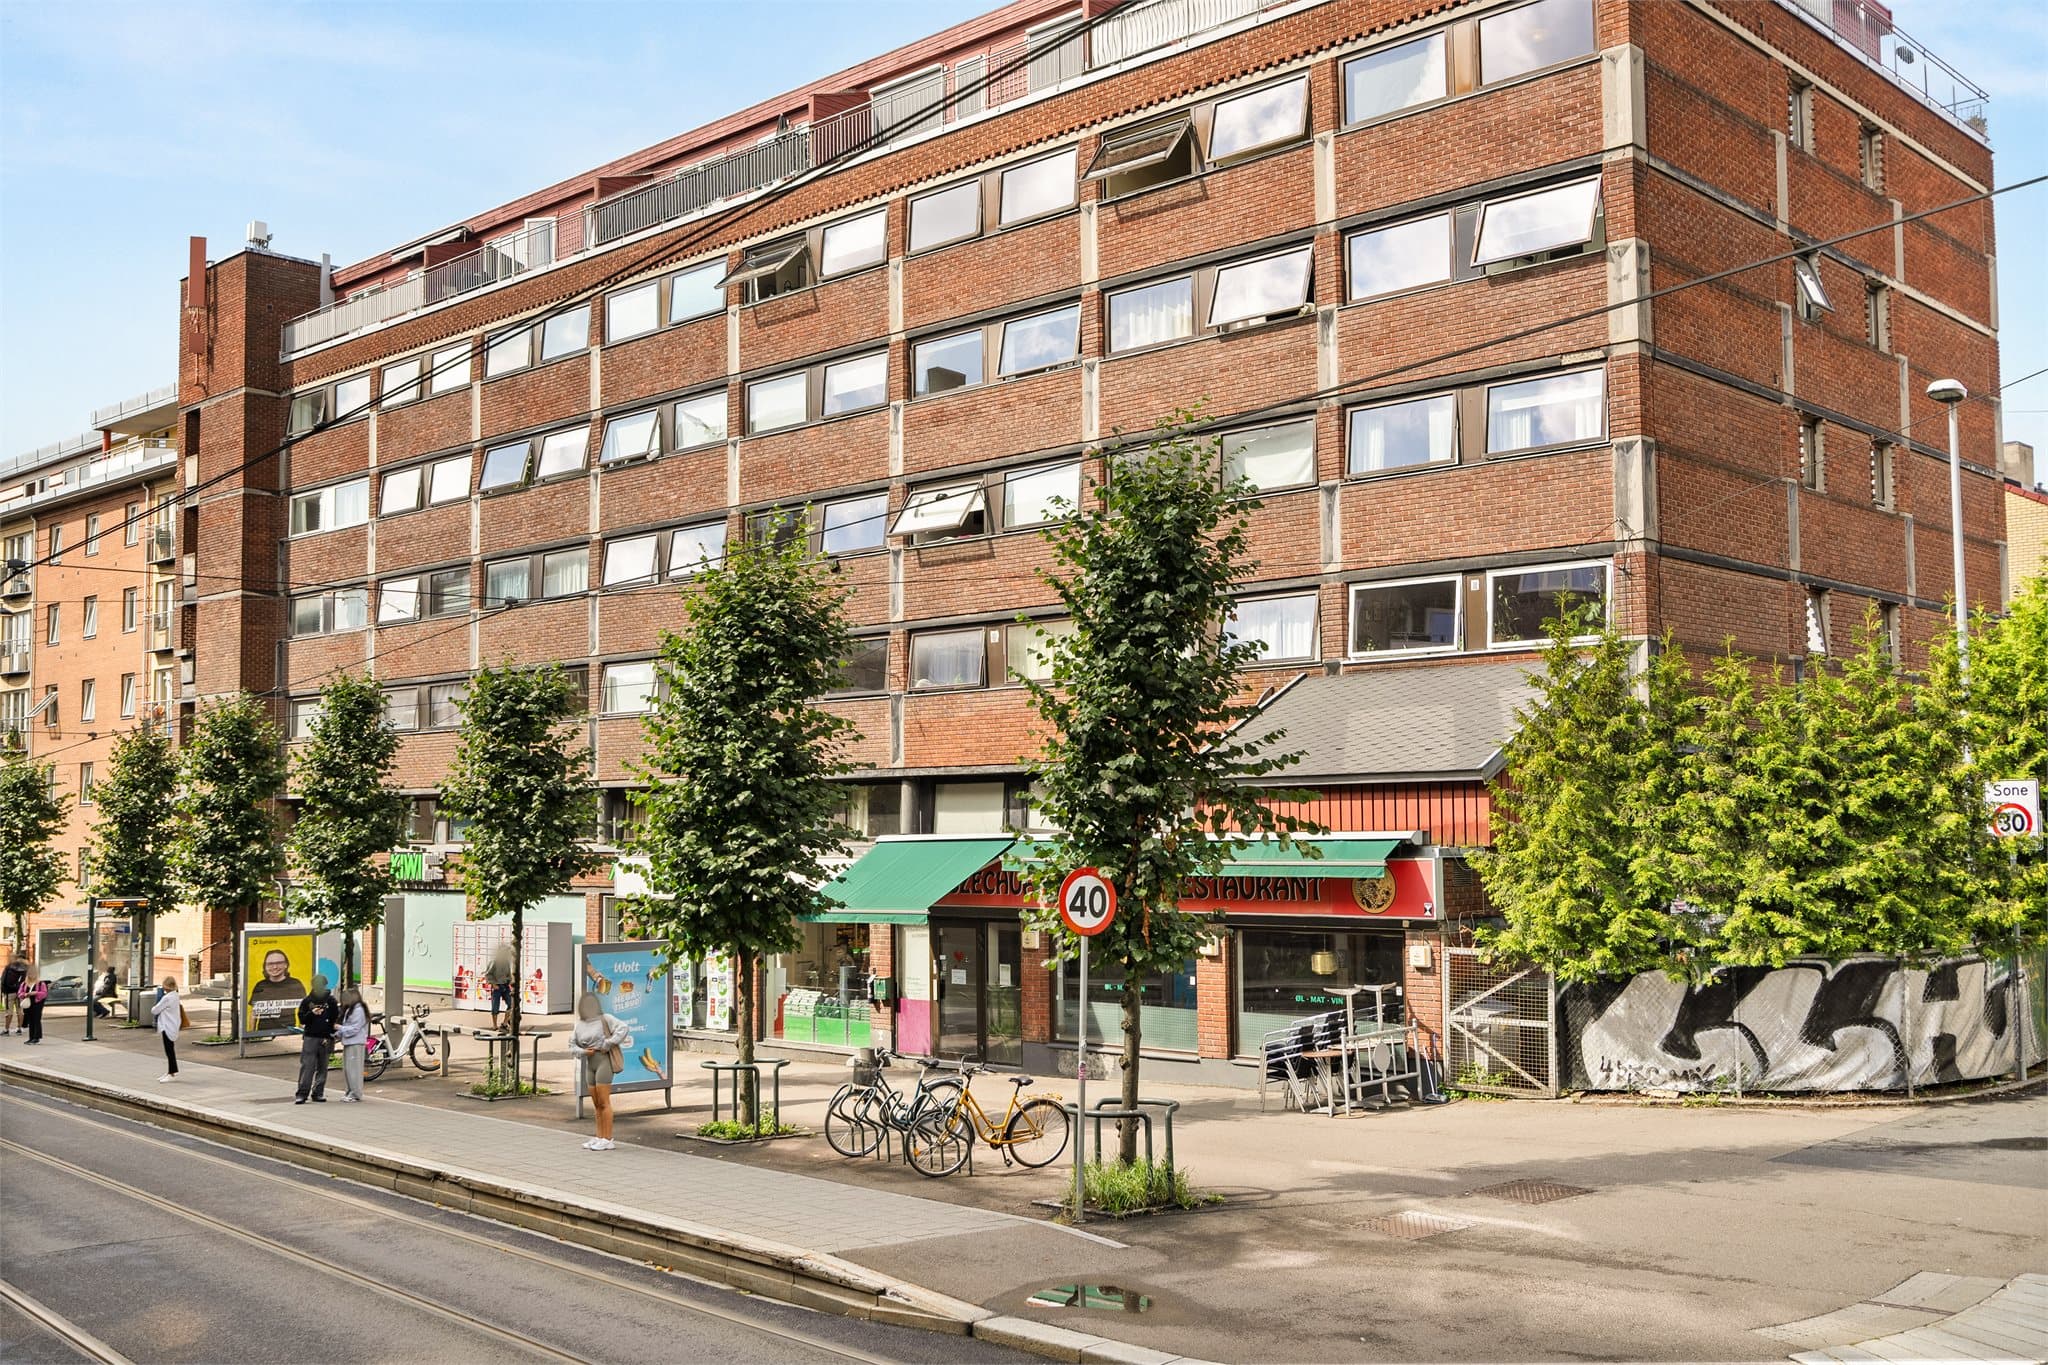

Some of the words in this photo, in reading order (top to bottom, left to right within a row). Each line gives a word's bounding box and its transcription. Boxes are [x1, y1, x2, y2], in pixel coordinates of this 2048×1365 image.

[1993, 784, 2028, 796] Sone
[1998, 812, 2025, 832] 30
[390, 853, 422, 880] KIWI
[1177, 875, 1326, 902] ESTAURANT
[1069, 886, 1106, 918] 40
[613, 961, 640, 973] Wolt
[1310, 995, 1325, 1004] MAT
[1331, 997, 1344, 1005] VIN
